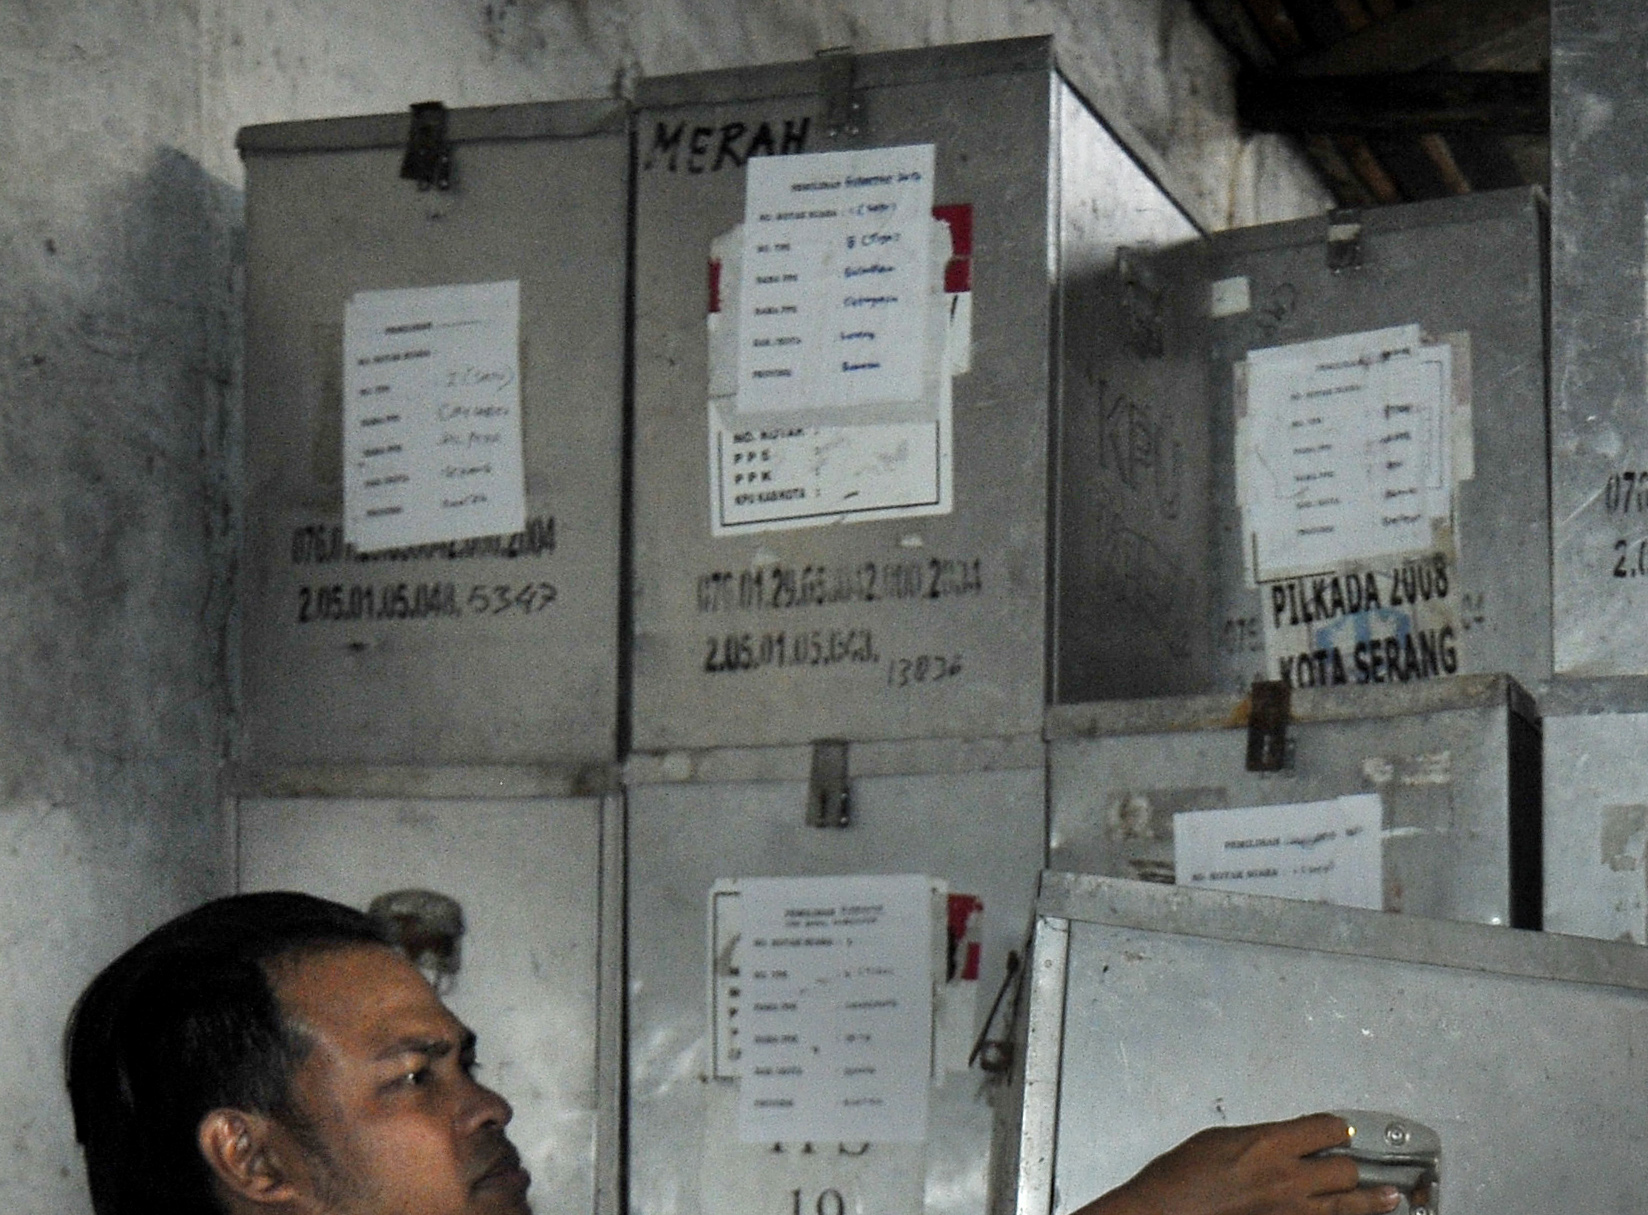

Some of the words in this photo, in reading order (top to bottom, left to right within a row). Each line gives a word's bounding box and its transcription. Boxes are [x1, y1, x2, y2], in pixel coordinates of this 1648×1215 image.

[643, 116, 811, 174] MERAH
[1272, 571, 1382, 629] PILKADA
[1280, 645, 1348, 690] KOTA
[1354, 624, 1458, 684] SERANG
